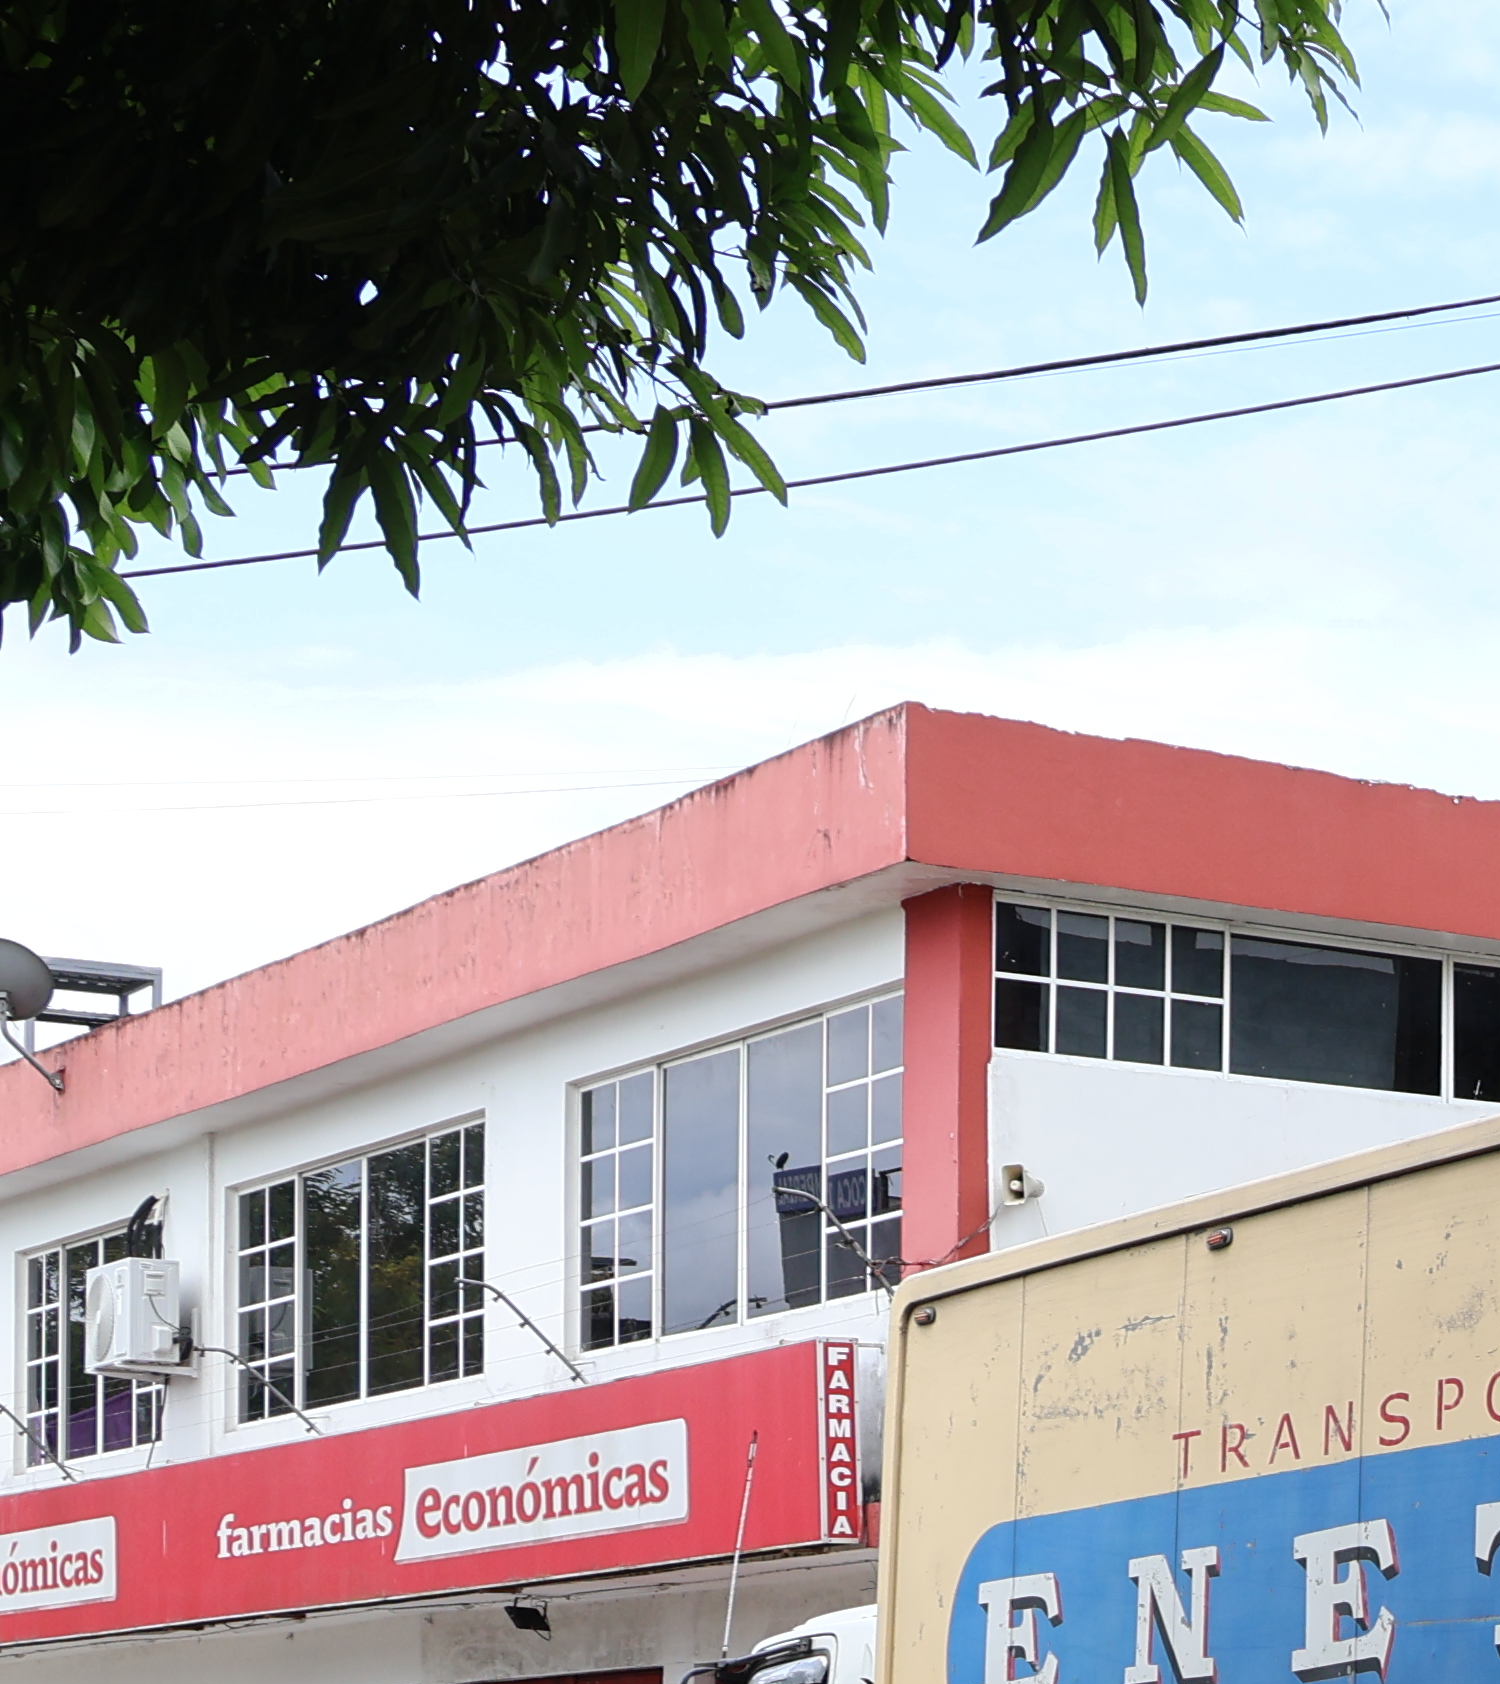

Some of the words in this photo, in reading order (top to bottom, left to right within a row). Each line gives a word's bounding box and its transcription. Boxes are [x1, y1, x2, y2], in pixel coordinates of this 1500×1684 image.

[828, 1346, 853, 1535] FARMACIA
[216, 1498, 393, 1558] farmacias
[415, 1451, 669, 1539] económicas
[0, 1541, 103, 1595] ómicas
